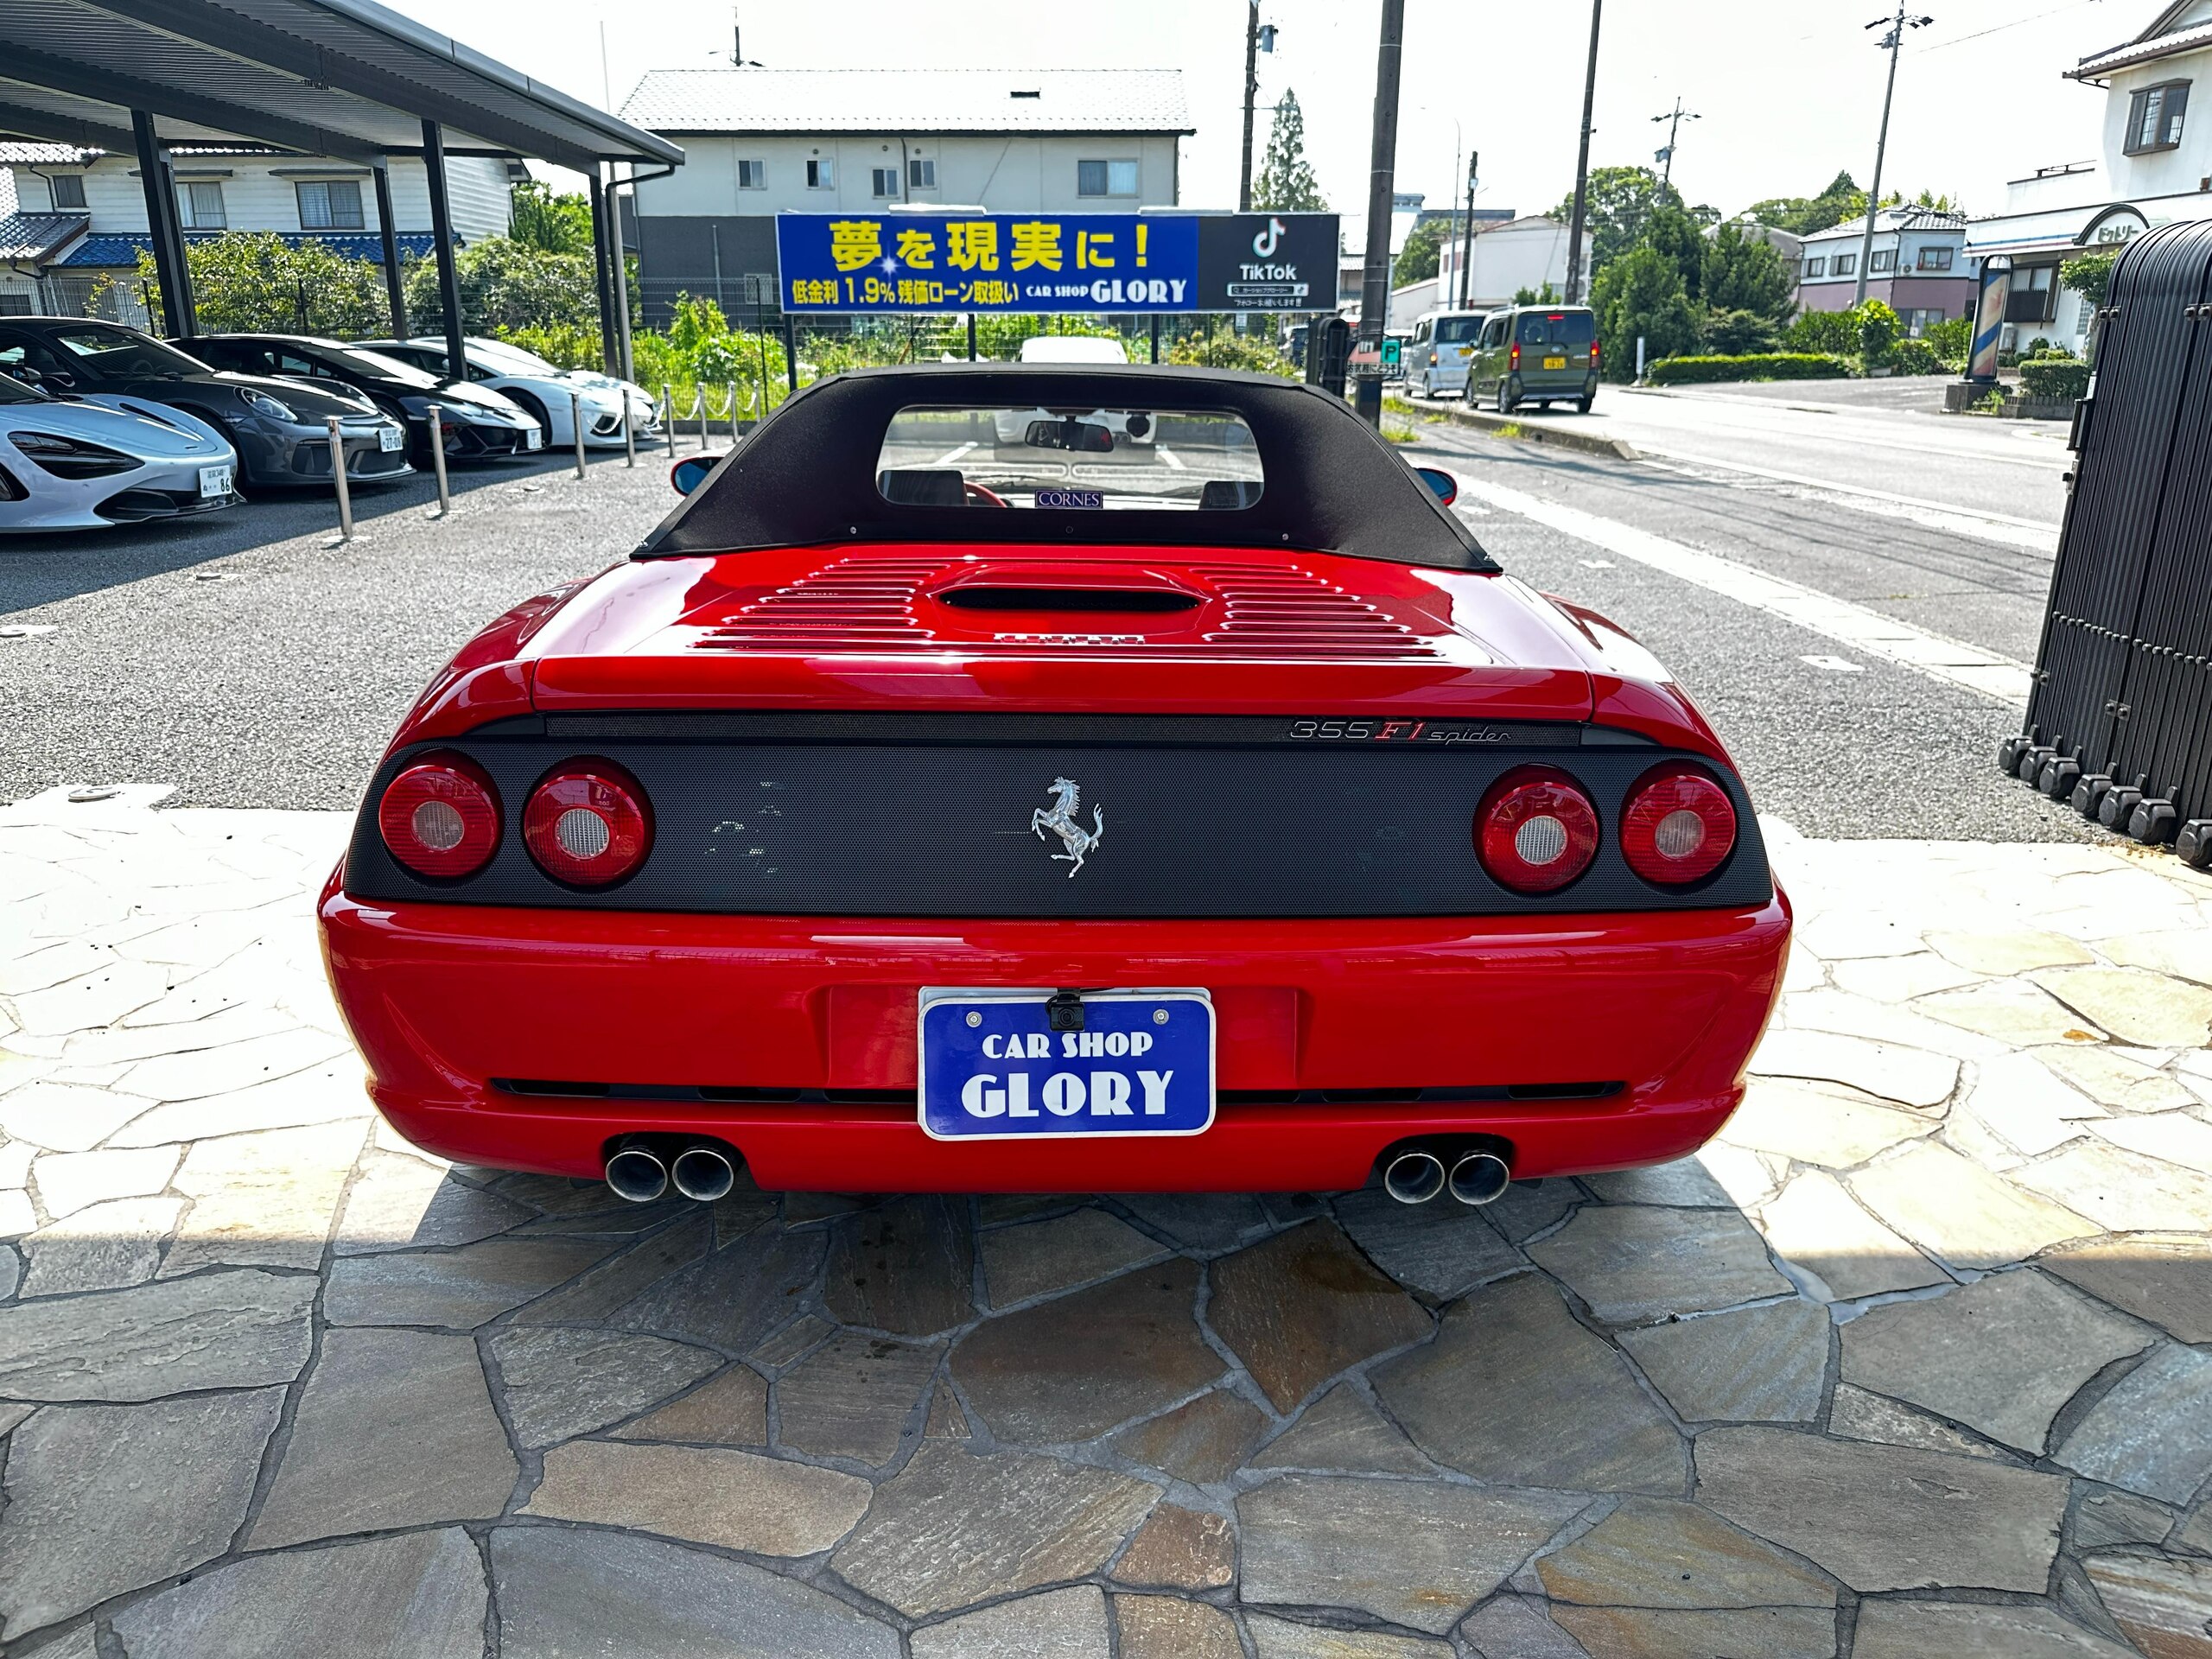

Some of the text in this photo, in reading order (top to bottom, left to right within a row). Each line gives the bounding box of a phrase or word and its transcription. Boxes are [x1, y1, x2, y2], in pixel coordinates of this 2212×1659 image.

[830, 221, 1147, 271] 夢を現実に!
[1239, 263, 1297, 280] TikTok
[792, 279, 839, 305] 低金利
[845, 277, 895, 304] 1.9%
[1026, 278, 1187, 303] CAR SHOP GLORY
[1385, 346, 1397, 360] P
[1039, 493, 1099, 506] CORNES
[1290, 721, 1511, 745] 355 F1 spider
[982, 1032, 1154, 1059] CAR SHOP
[961, 1070, 1174, 1118] GLORY
